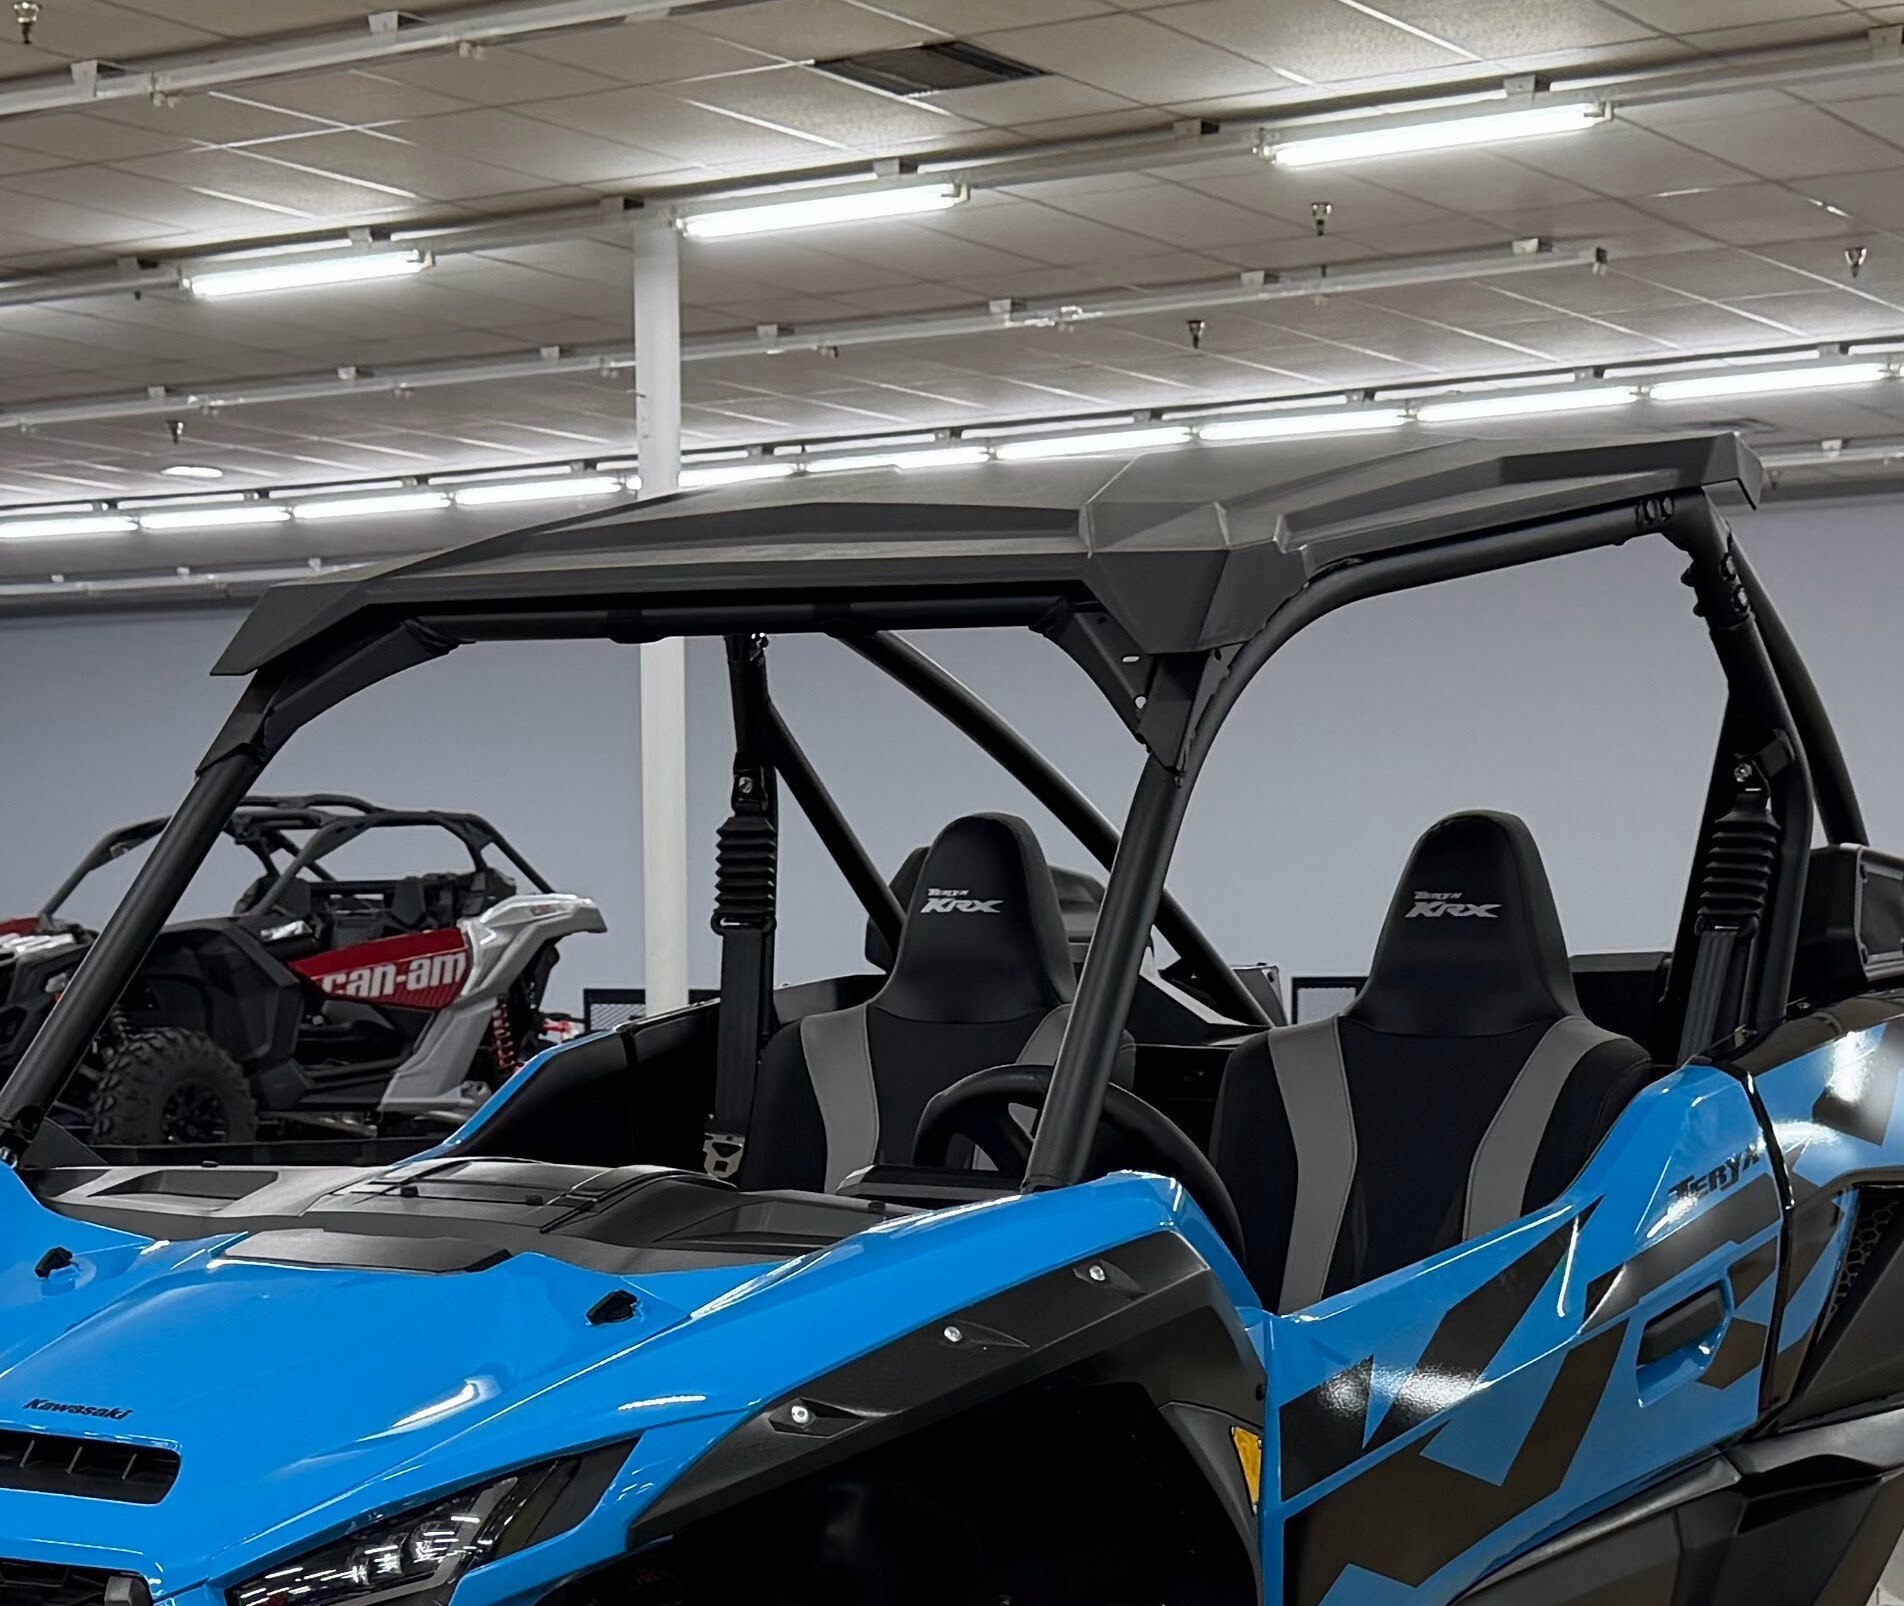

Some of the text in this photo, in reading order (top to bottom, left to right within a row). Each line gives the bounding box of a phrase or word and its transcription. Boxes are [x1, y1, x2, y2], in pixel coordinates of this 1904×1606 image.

[920, 897, 1005, 913] KRX
[1405, 901, 1503, 918] KRX
[322, 952, 467, 998] can-am
[22, 1398, 134, 1421] Kawasaki
